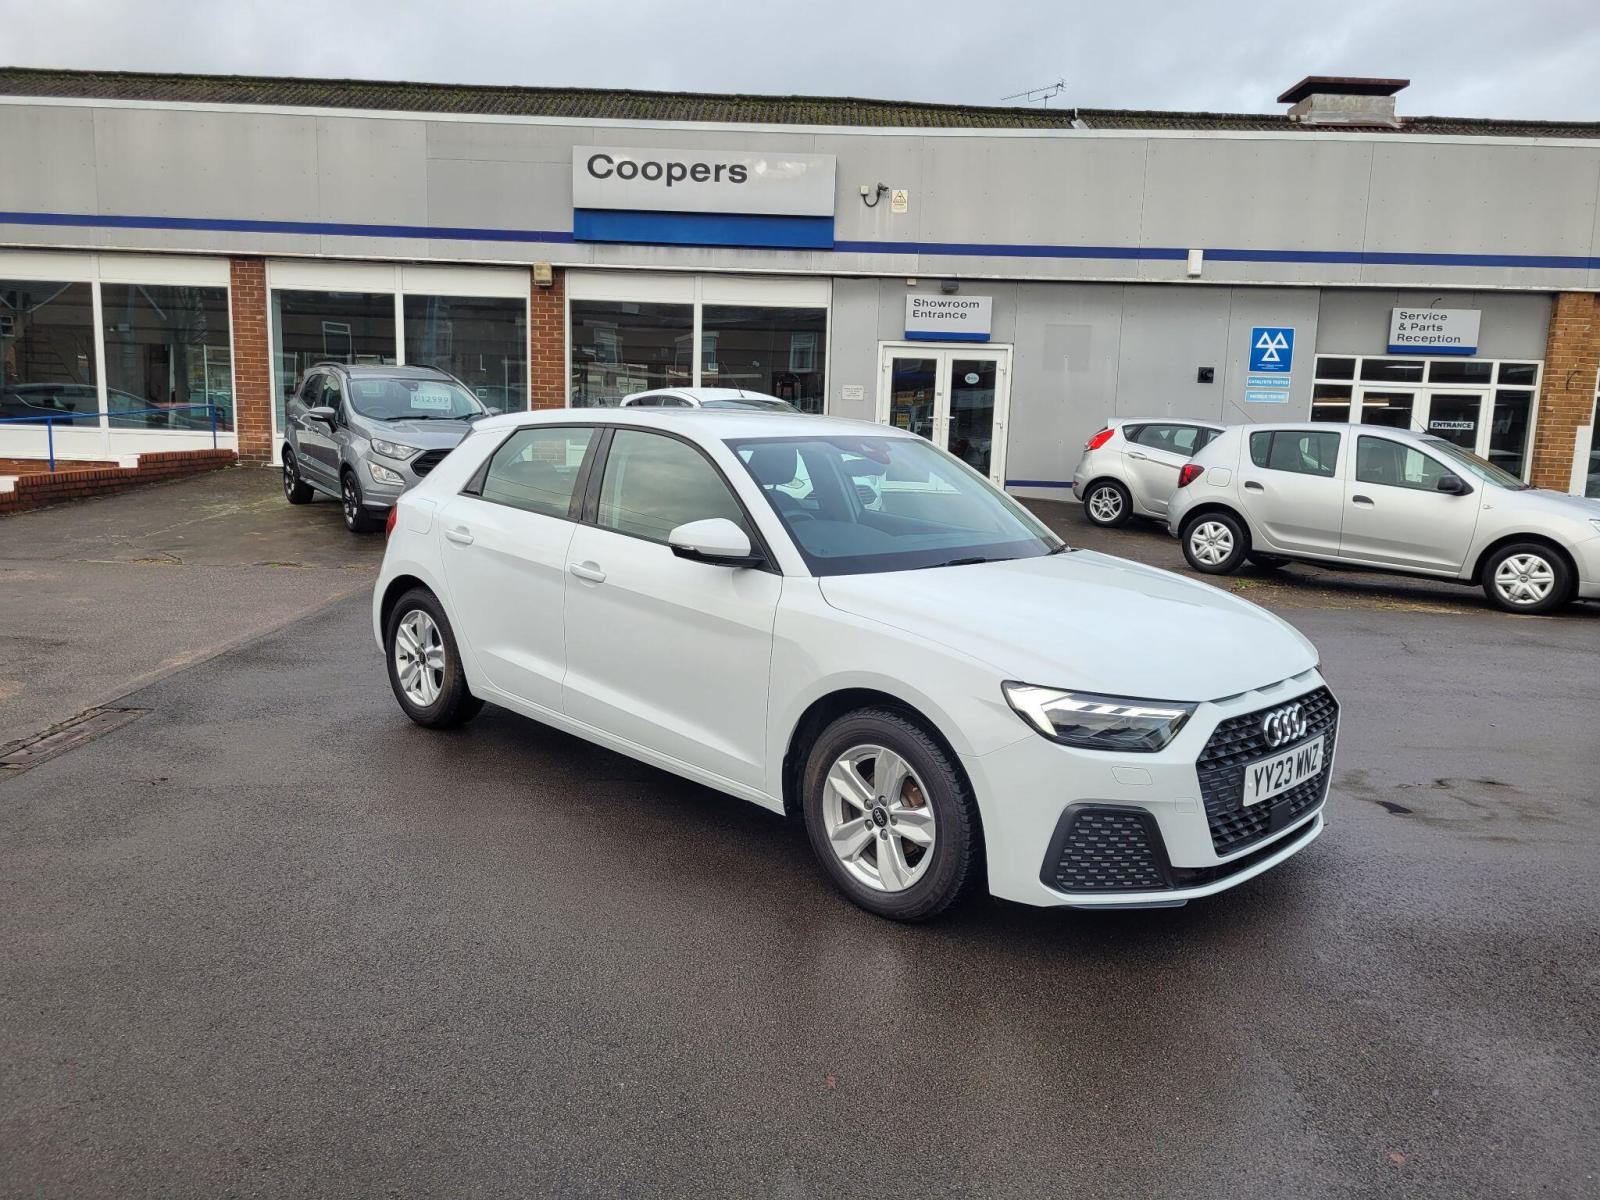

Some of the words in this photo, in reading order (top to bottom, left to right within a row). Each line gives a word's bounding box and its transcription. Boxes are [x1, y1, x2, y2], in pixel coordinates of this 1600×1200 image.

[587, 153, 748, 187] Coopers
[913, 298, 980, 309] Showroom
[912, 309, 968, 320] Entrance
[1399, 311, 1448, 321] Service
[1398, 322, 1407, 331] &
[1410, 322, 1444, 332] Parts
[1396, 333, 1461, 344] Reception
[1432, 421, 1473, 429] ENTRANCE
[1254, 755, 1294, 797] YY23
[1295, 742, 1320, 780] WNZ
